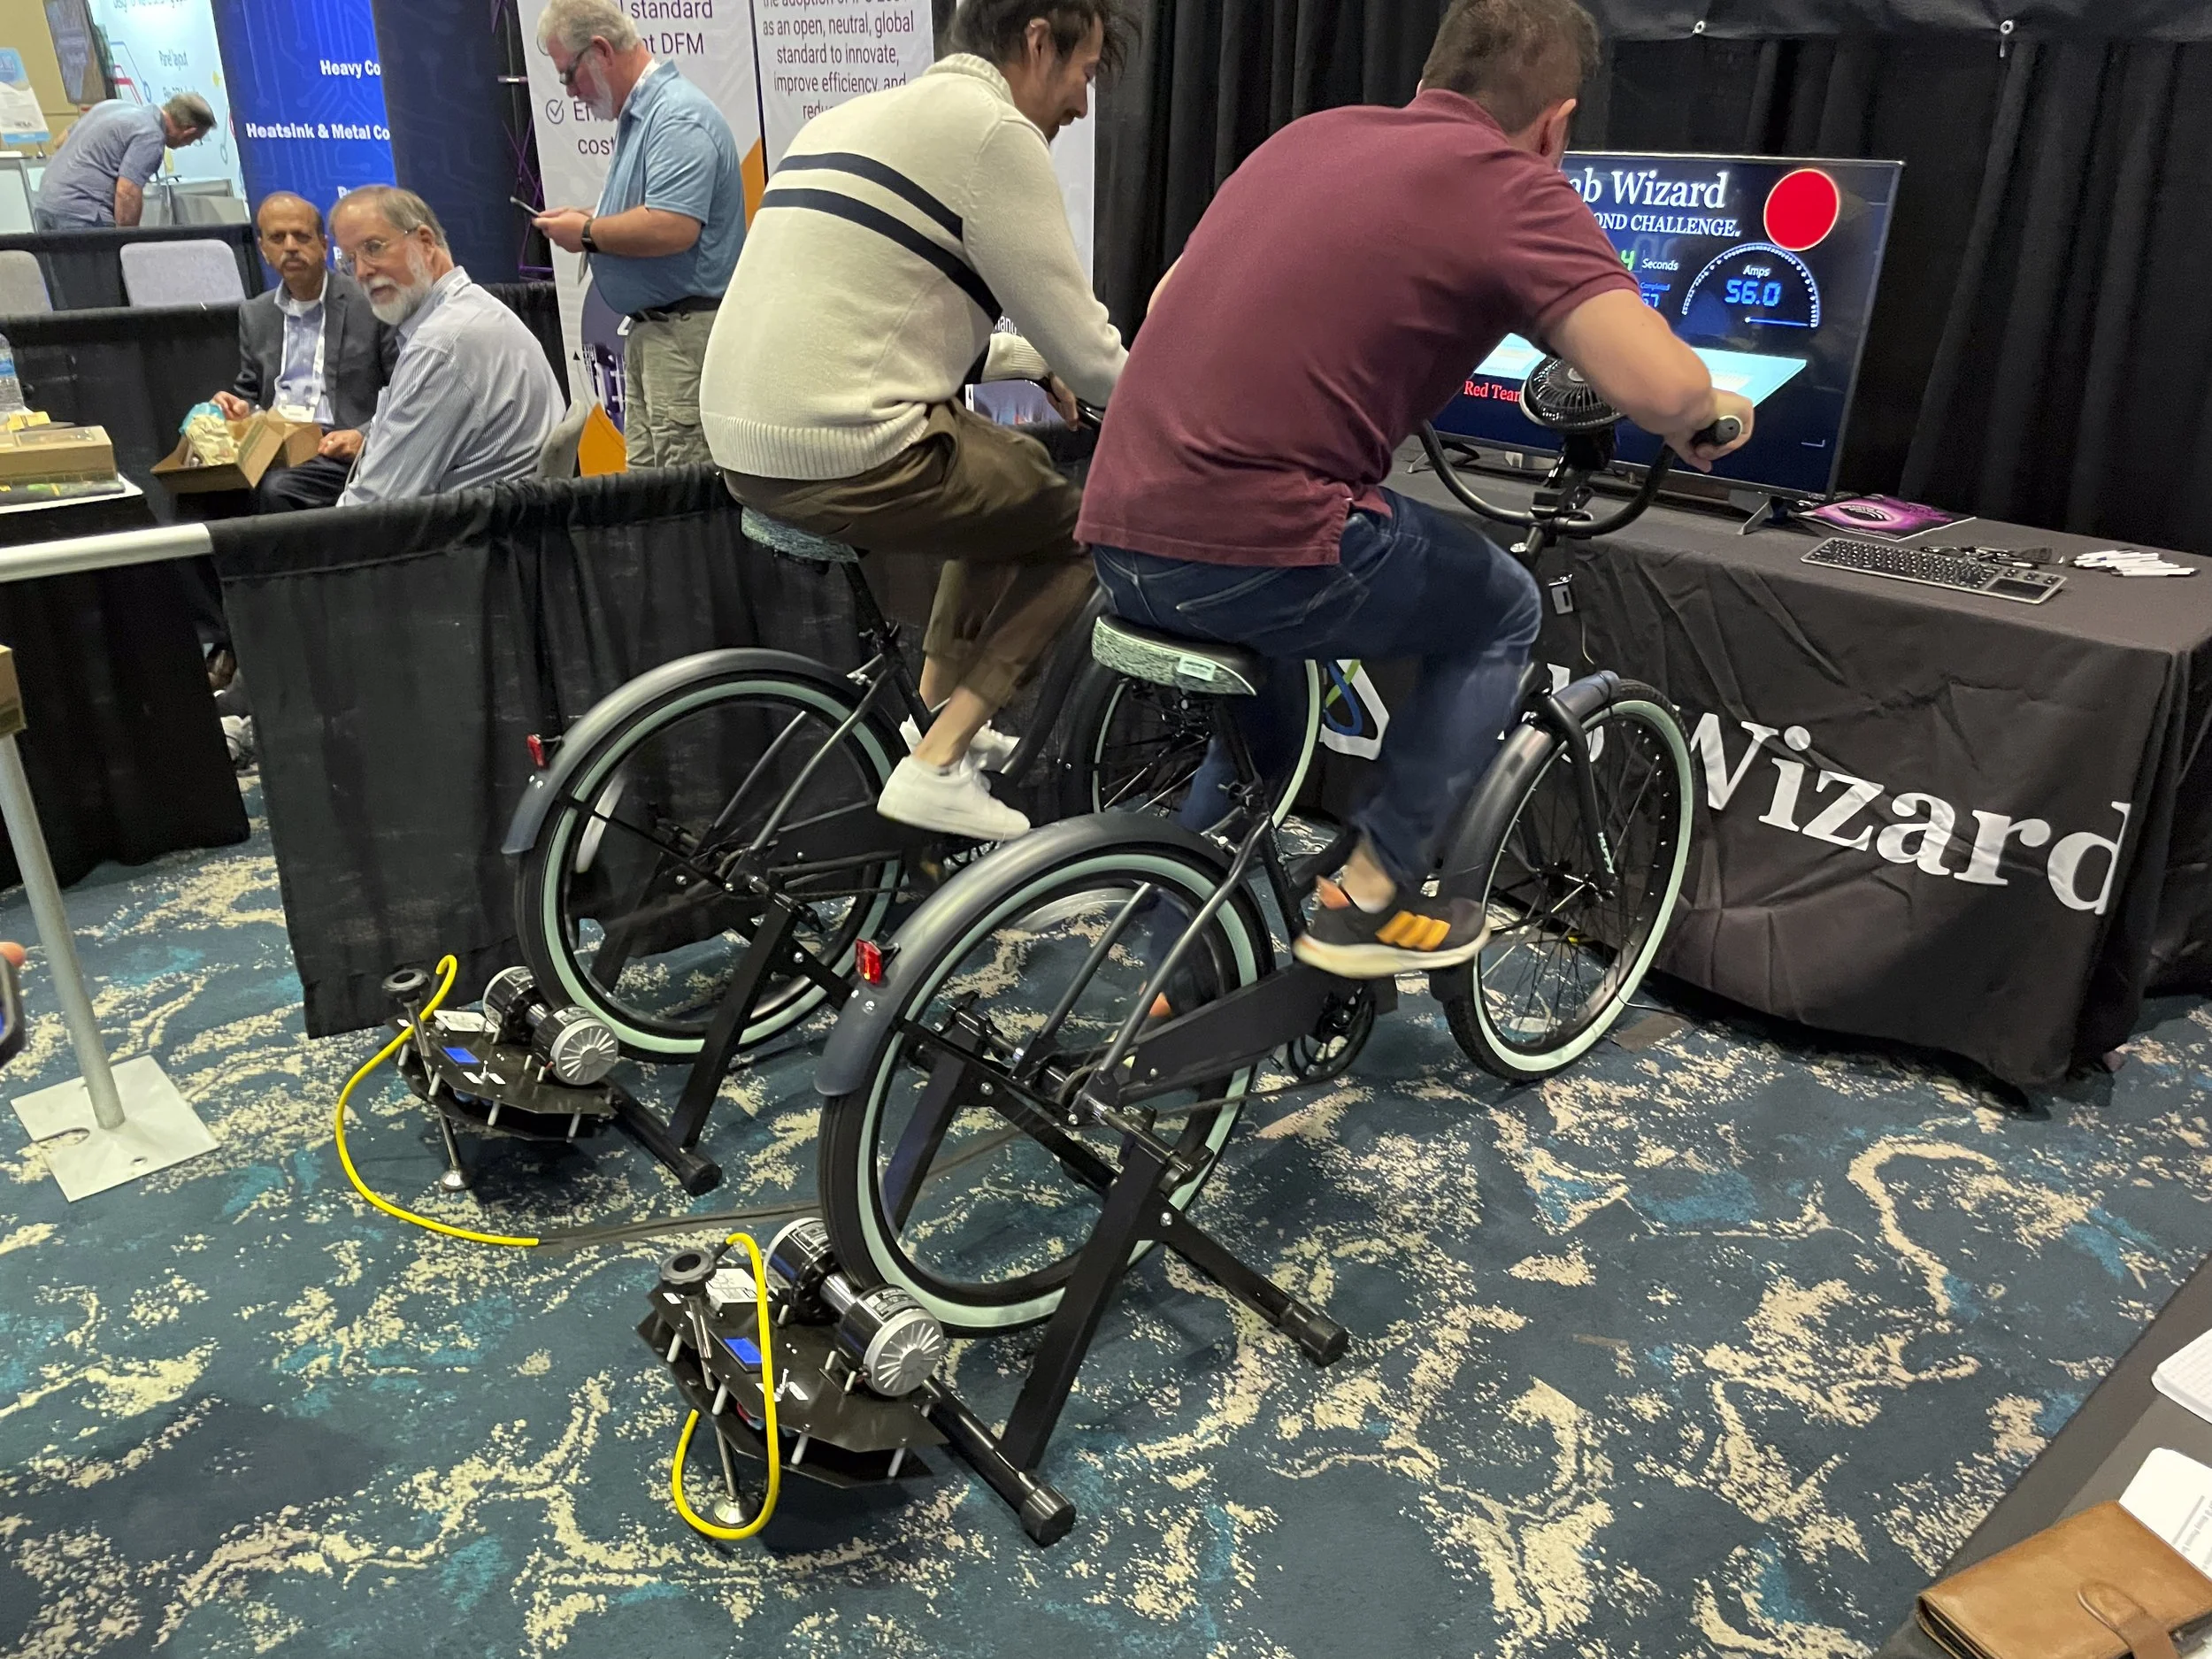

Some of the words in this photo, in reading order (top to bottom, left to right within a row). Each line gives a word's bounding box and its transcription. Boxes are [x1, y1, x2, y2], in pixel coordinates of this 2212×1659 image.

[631, 0, 713, 19] standard
[763, 20, 774, 35] as
[778, 20, 790, 35] an
[794, 19, 826, 40] open,
[828, 12, 872, 36] neutral,
[875, 10, 914, 38] global
[661, 32, 704, 55] DFM
[777, 43, 827, 65] standard
[830, 47, 841, 64] to
[845, 42, 900, 67] innovate,
[319, 59, 362, 79] Heavy
[773, 70, 818, 96] improve
[246, 122, 316, 139] Heatsink
[318, 123, 330, 140] &
[331, 124, 372, 141] Metal
[1610, 169, 1731, 210] Wizard
[1630, 213, 1742, 238] CHALLENGE.
[1641, 257, 1679, 272] Seconds
[1742, 265, 1770, 278] Amps
[1724, 279, 1782, 308] 56.0
[1463, 380, 1489, 398] Red
[1690, 711, 2131, 916] Wizard
